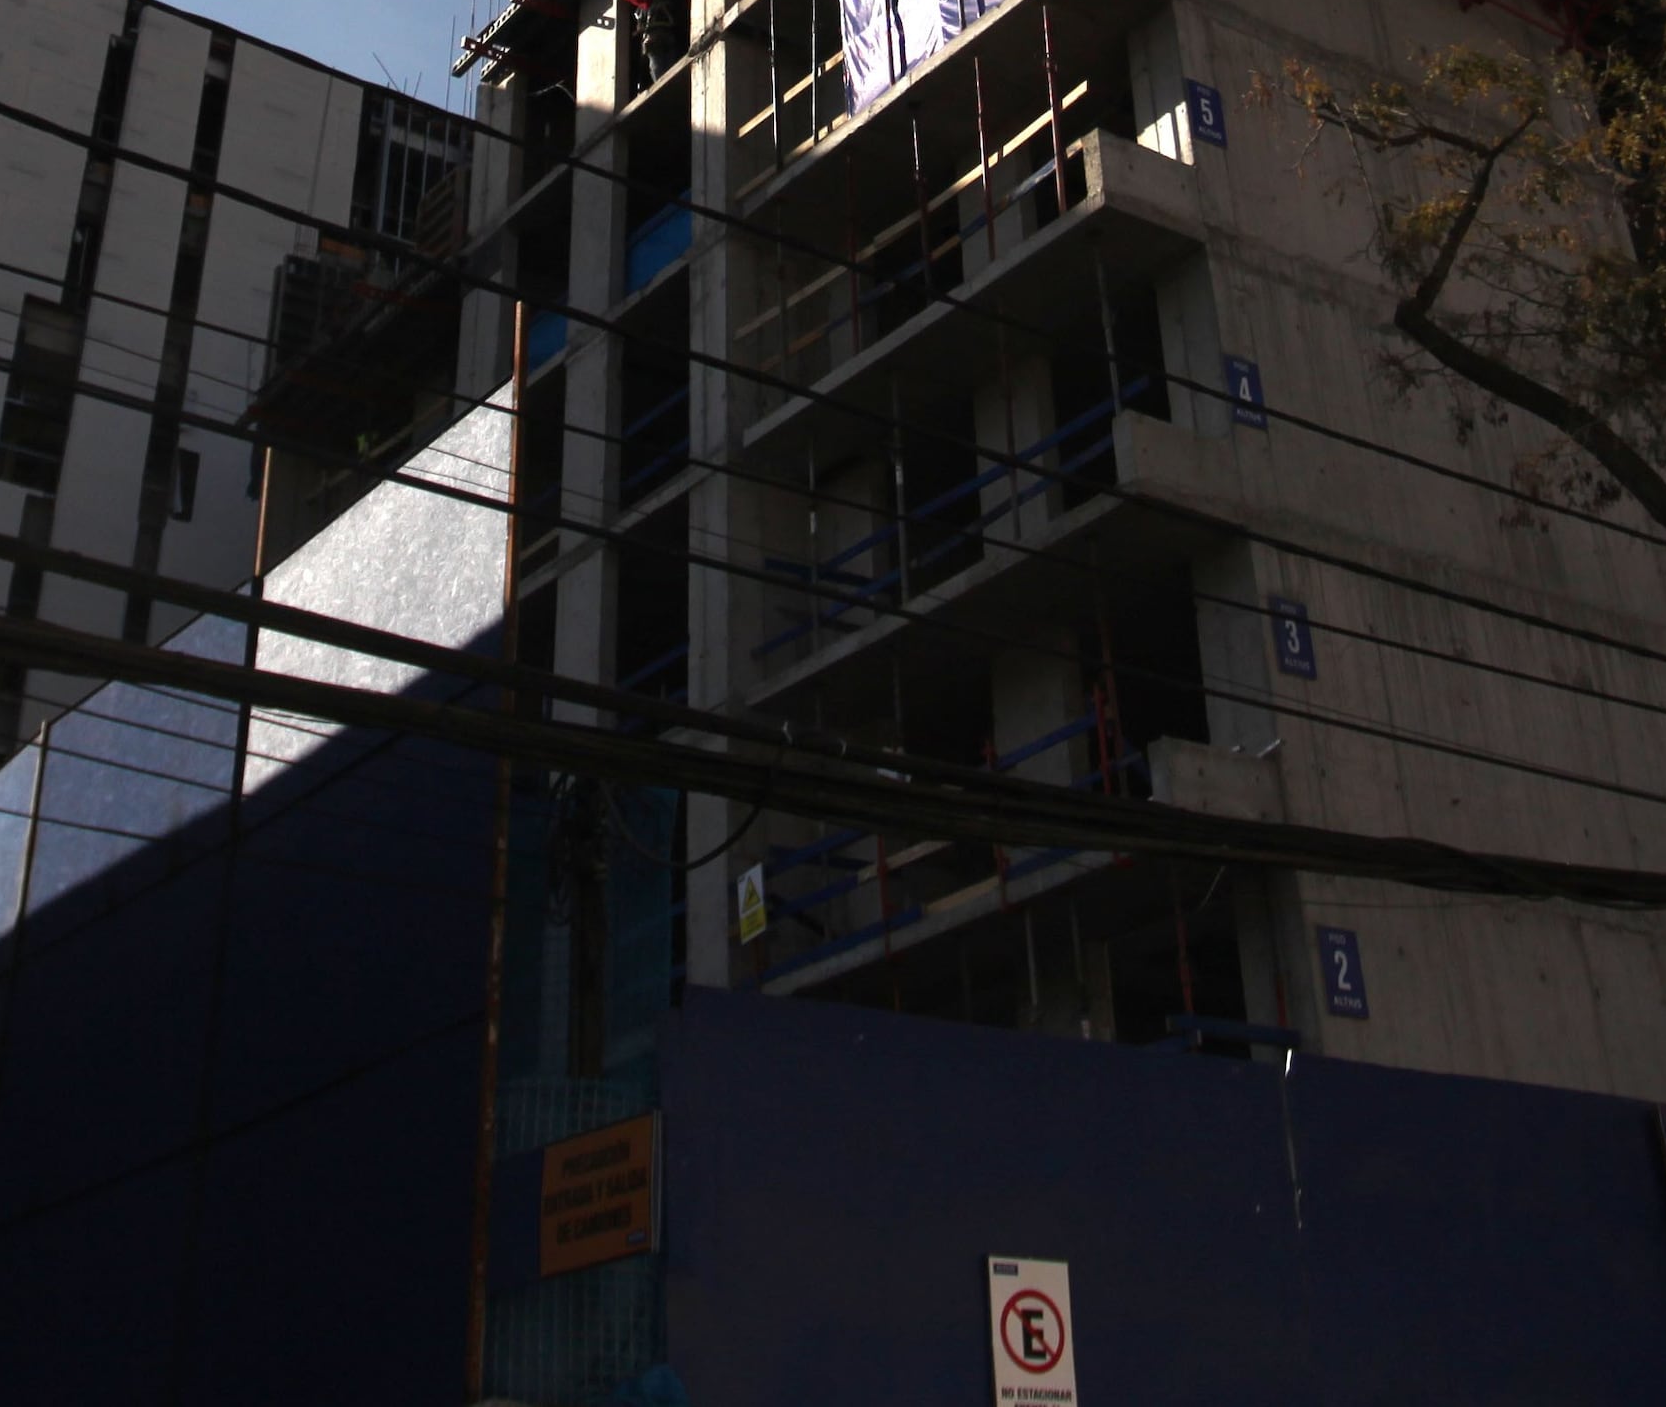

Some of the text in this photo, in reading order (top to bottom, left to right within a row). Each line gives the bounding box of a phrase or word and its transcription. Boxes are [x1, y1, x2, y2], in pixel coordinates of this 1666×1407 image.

[1199, 97, 1214, 126] 5
[1239, 376, 1253, 403] 4
[1284, 619, 1301, 654] 3
[1333, 950, 1352, 991] 2
[1021, 1309, 1047, 1360] E
[1001, 1386, 1072, 1403] NO ESTACIONAR
